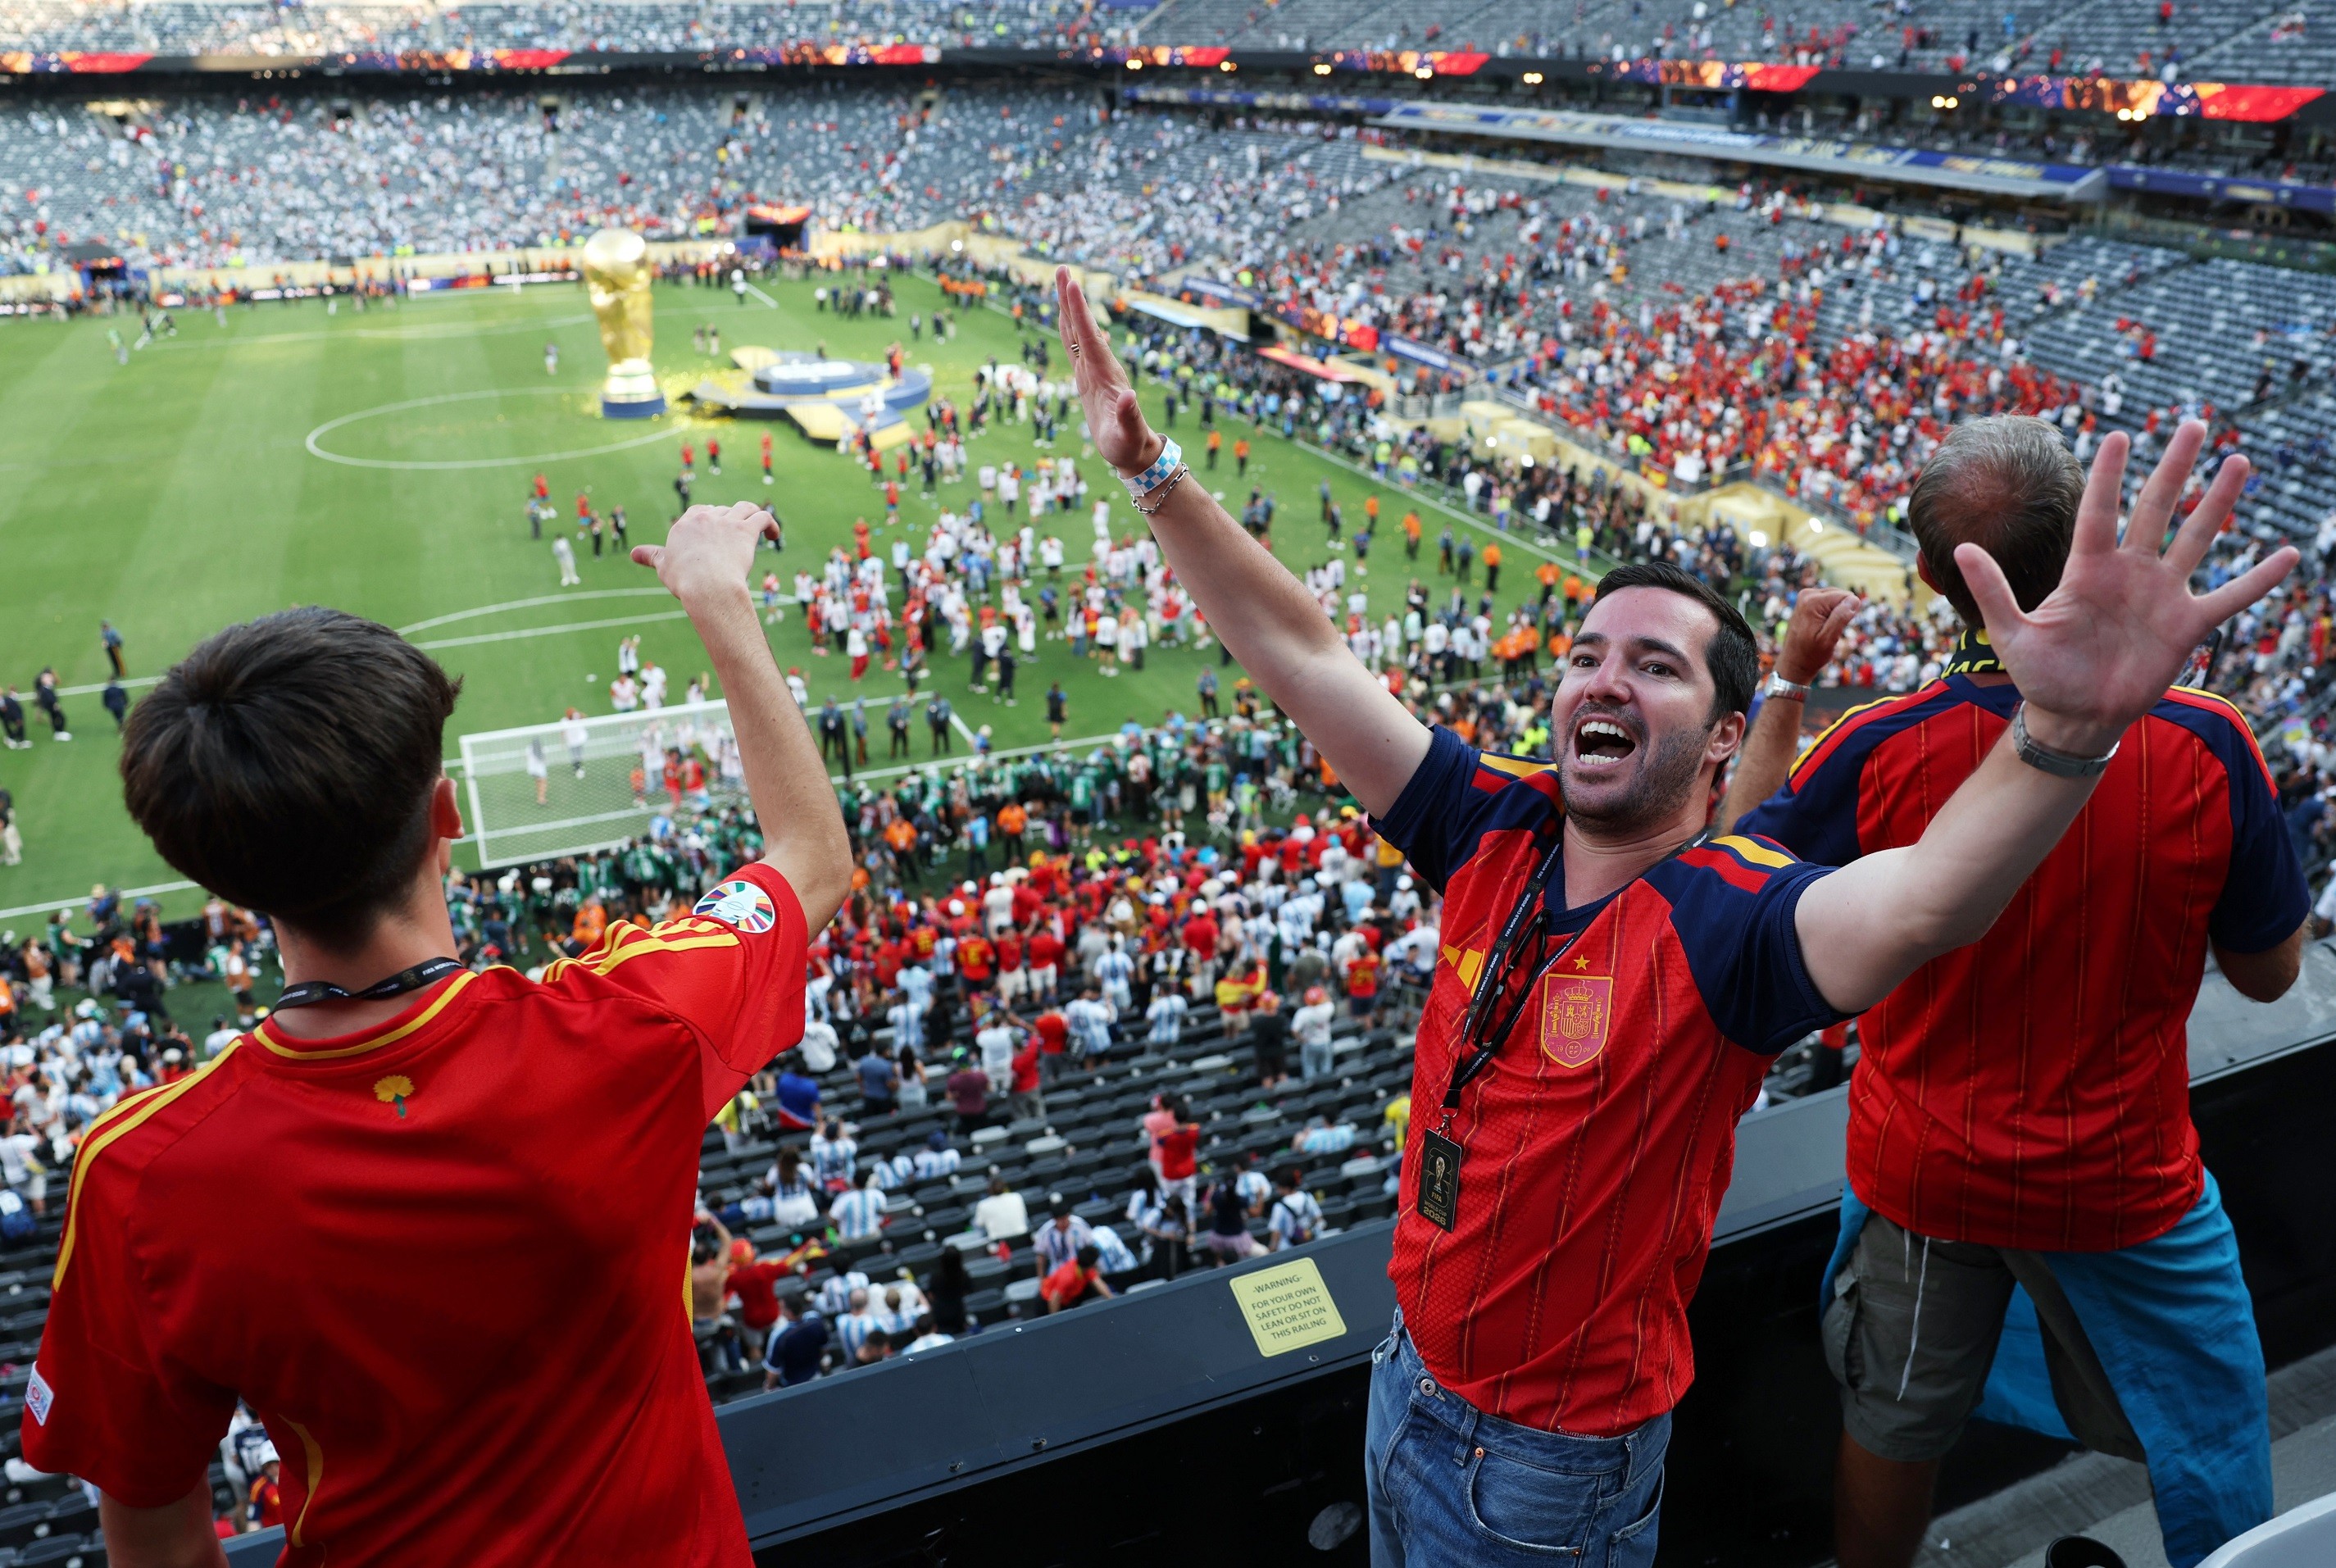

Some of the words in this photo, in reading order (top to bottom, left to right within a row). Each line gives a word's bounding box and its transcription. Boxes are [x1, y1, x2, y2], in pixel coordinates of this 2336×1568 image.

[1510, 914, 1520, 929] WORLD
[1479, 976, 1488, 991] WORLD
[1471, 1057, 1483, 1070] WORLD
[1431, 1191, 1443, 1203] FIFA
[1423, 1206, 1447, 1226] 2026
[1424, 1199, 1439, 1212] WORLD
[1438, 1209, 1448, 1217] CUP
[1251, 1298, 1270, 1311] FOR
[1270, 1293, 1295, 1307] YOUR
[1295, 1286, 1317, 1298] OWN
[1256, 1306, 1288, 1321] SAFETY
[1288, 1300, 1303, 1311] DO
[1303, 1296, 1322, 1308] NOT
[1261, 1318, 1285, 1331] LEAN
[1285, 1313, 1299, 1325] OR
[1299, 1310, 1311, 1320] SIT
[1312, 1306, 1327, 1316] ON
[1270, 1329, 1292, 1340] THIS
[1292, 1318, 1328, 1334] RAILING
